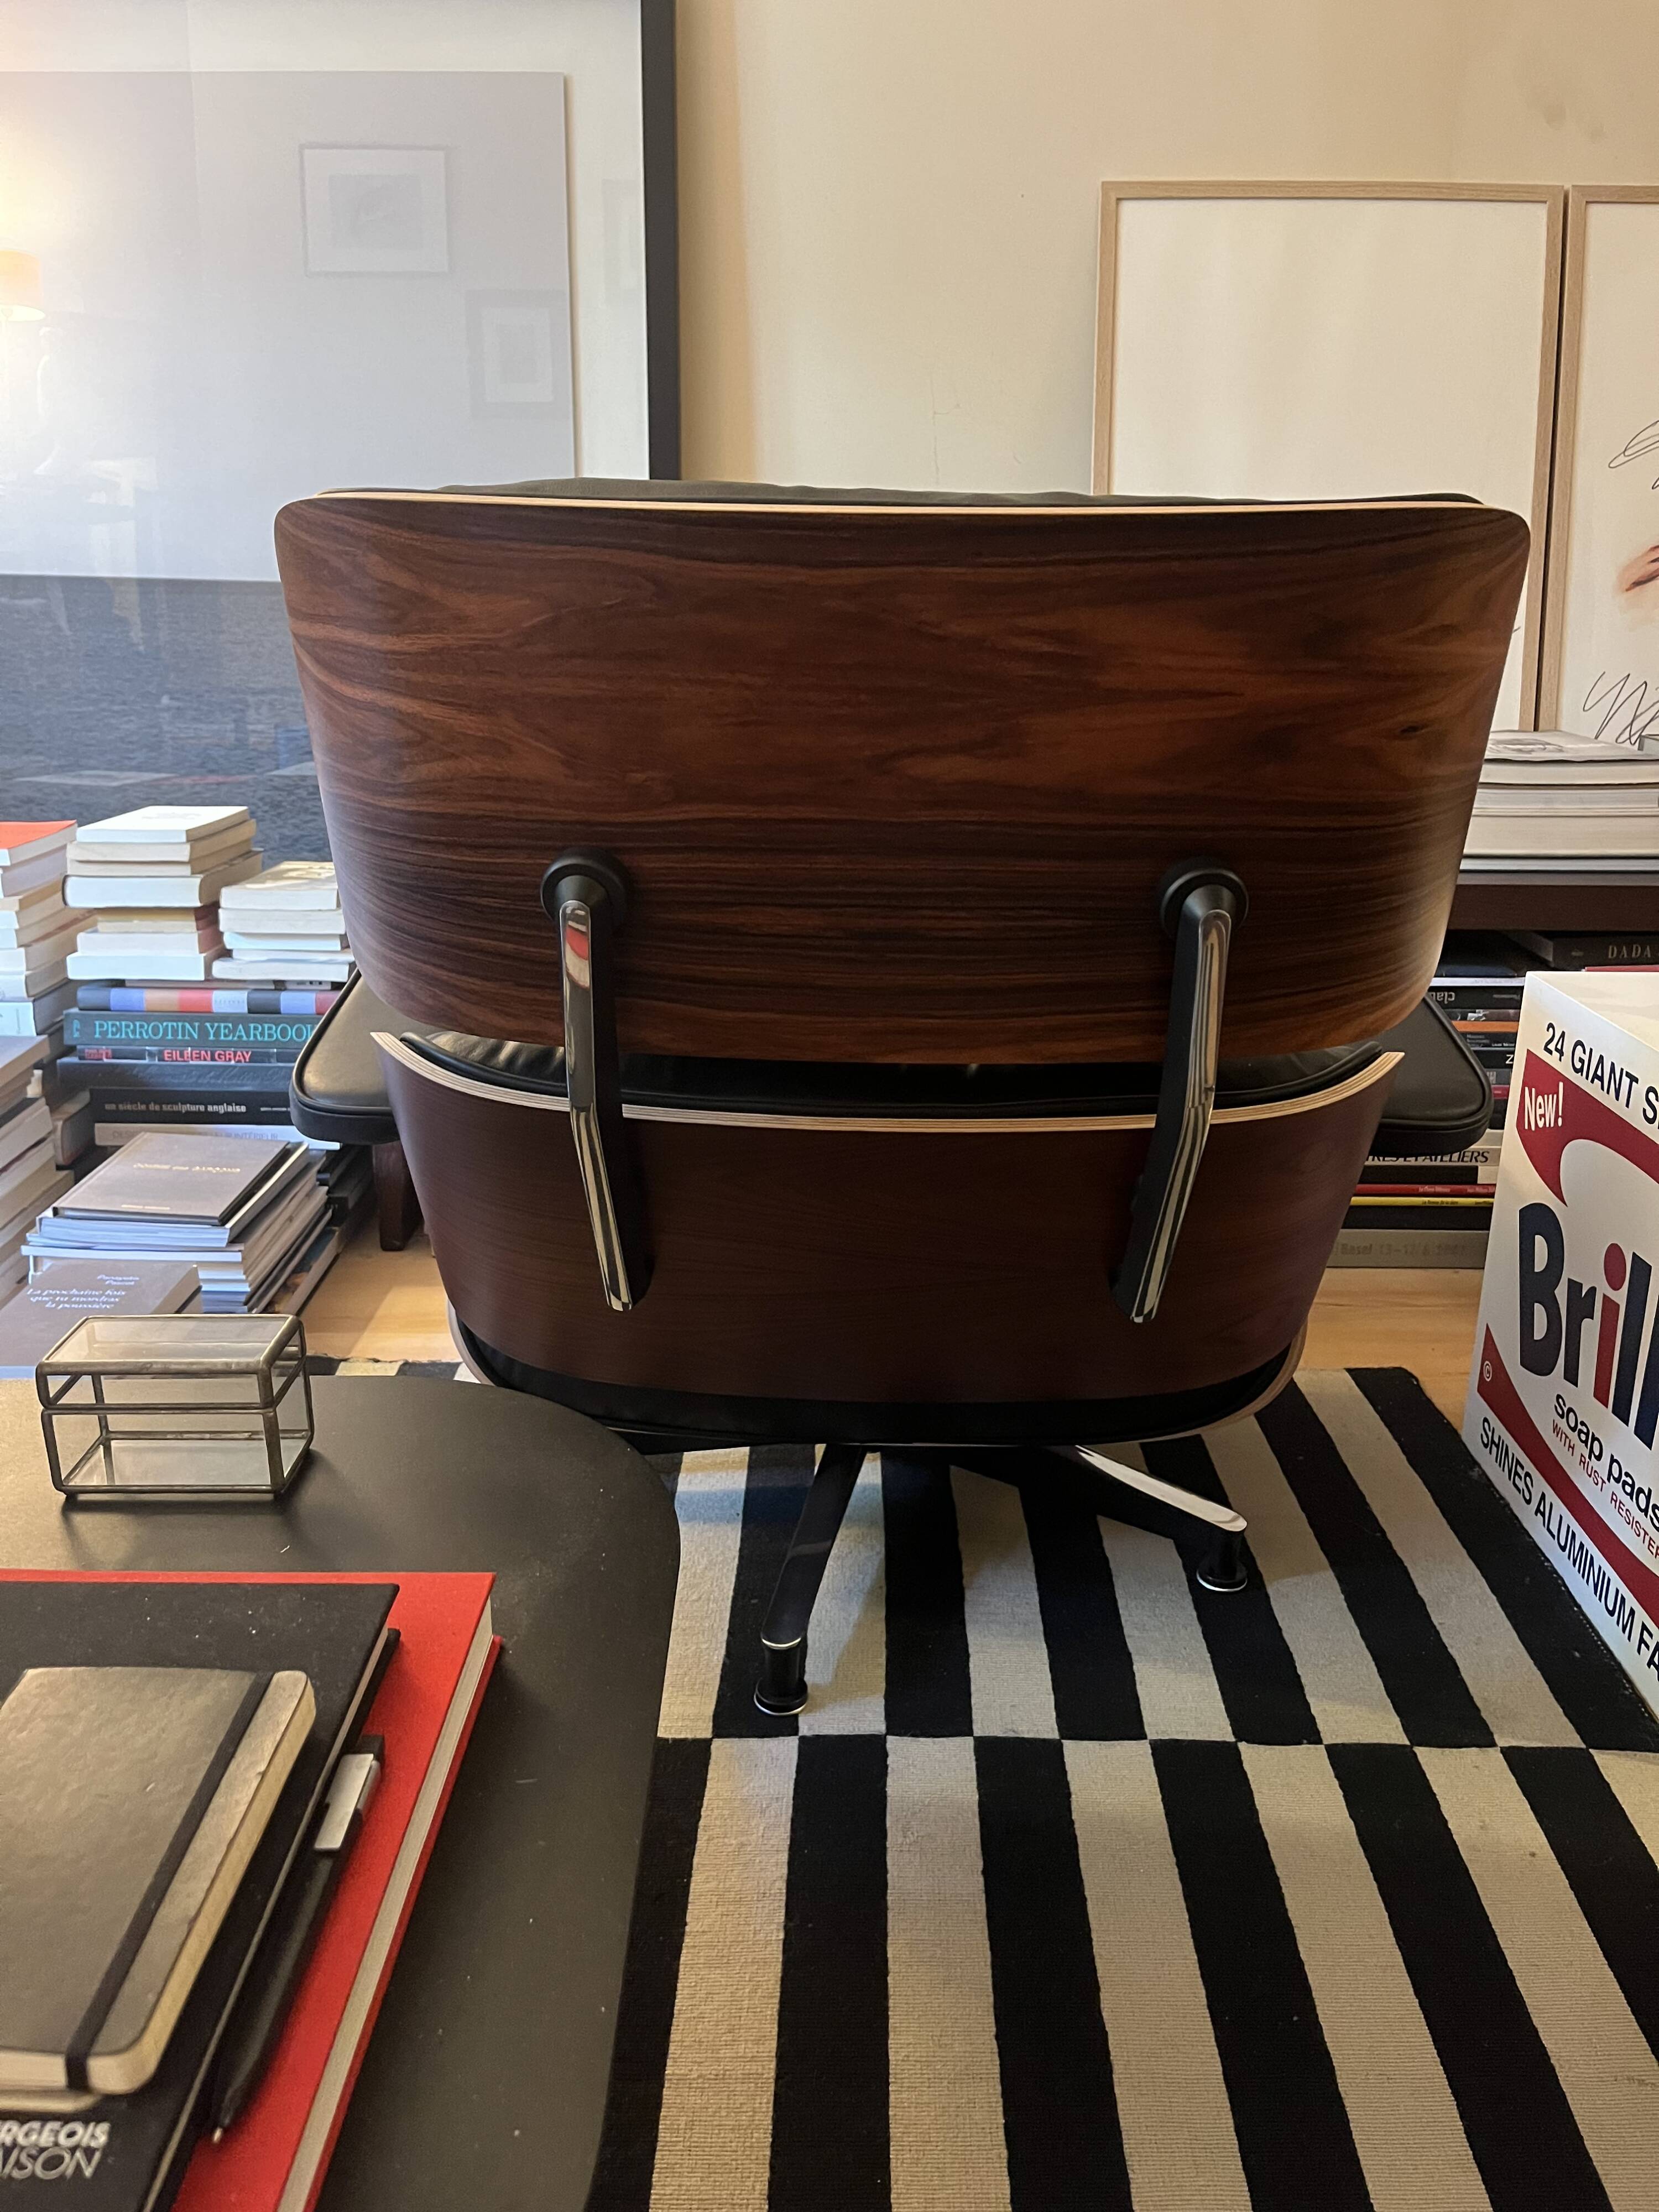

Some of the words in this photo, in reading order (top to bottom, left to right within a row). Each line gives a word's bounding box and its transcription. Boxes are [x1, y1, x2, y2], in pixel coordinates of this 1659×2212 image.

[1608, 945, 1651, 959] DADA
[94, 1021, 200, 1040] PERROTIN
[164, 1050, 211, 1061] EILEEN
[215, 1051, 252, 1062] GRAY
[1543, 1022, 1566, 1062] 24
[1571, 1040, 1639, 1109] GIANT
[1642, 1086, 1659, 1129] S
[163, 1102, 205, 1113] sculpture
[207, 1103, 247, 1114] anglaise
[1525, 1082, 1564, 1131] New!
[1554, 1394, 1603, 1462] soap
[1553, 1418, 1575, 1457] WITH
[1579, 1452, 1606, 1492] RUST
[1480, 1417, 1533, 1505] SHINES
[1535, 1491, 1635, 1642] ALUMINIUM
[0, 2145, 103, 2180] ISON
